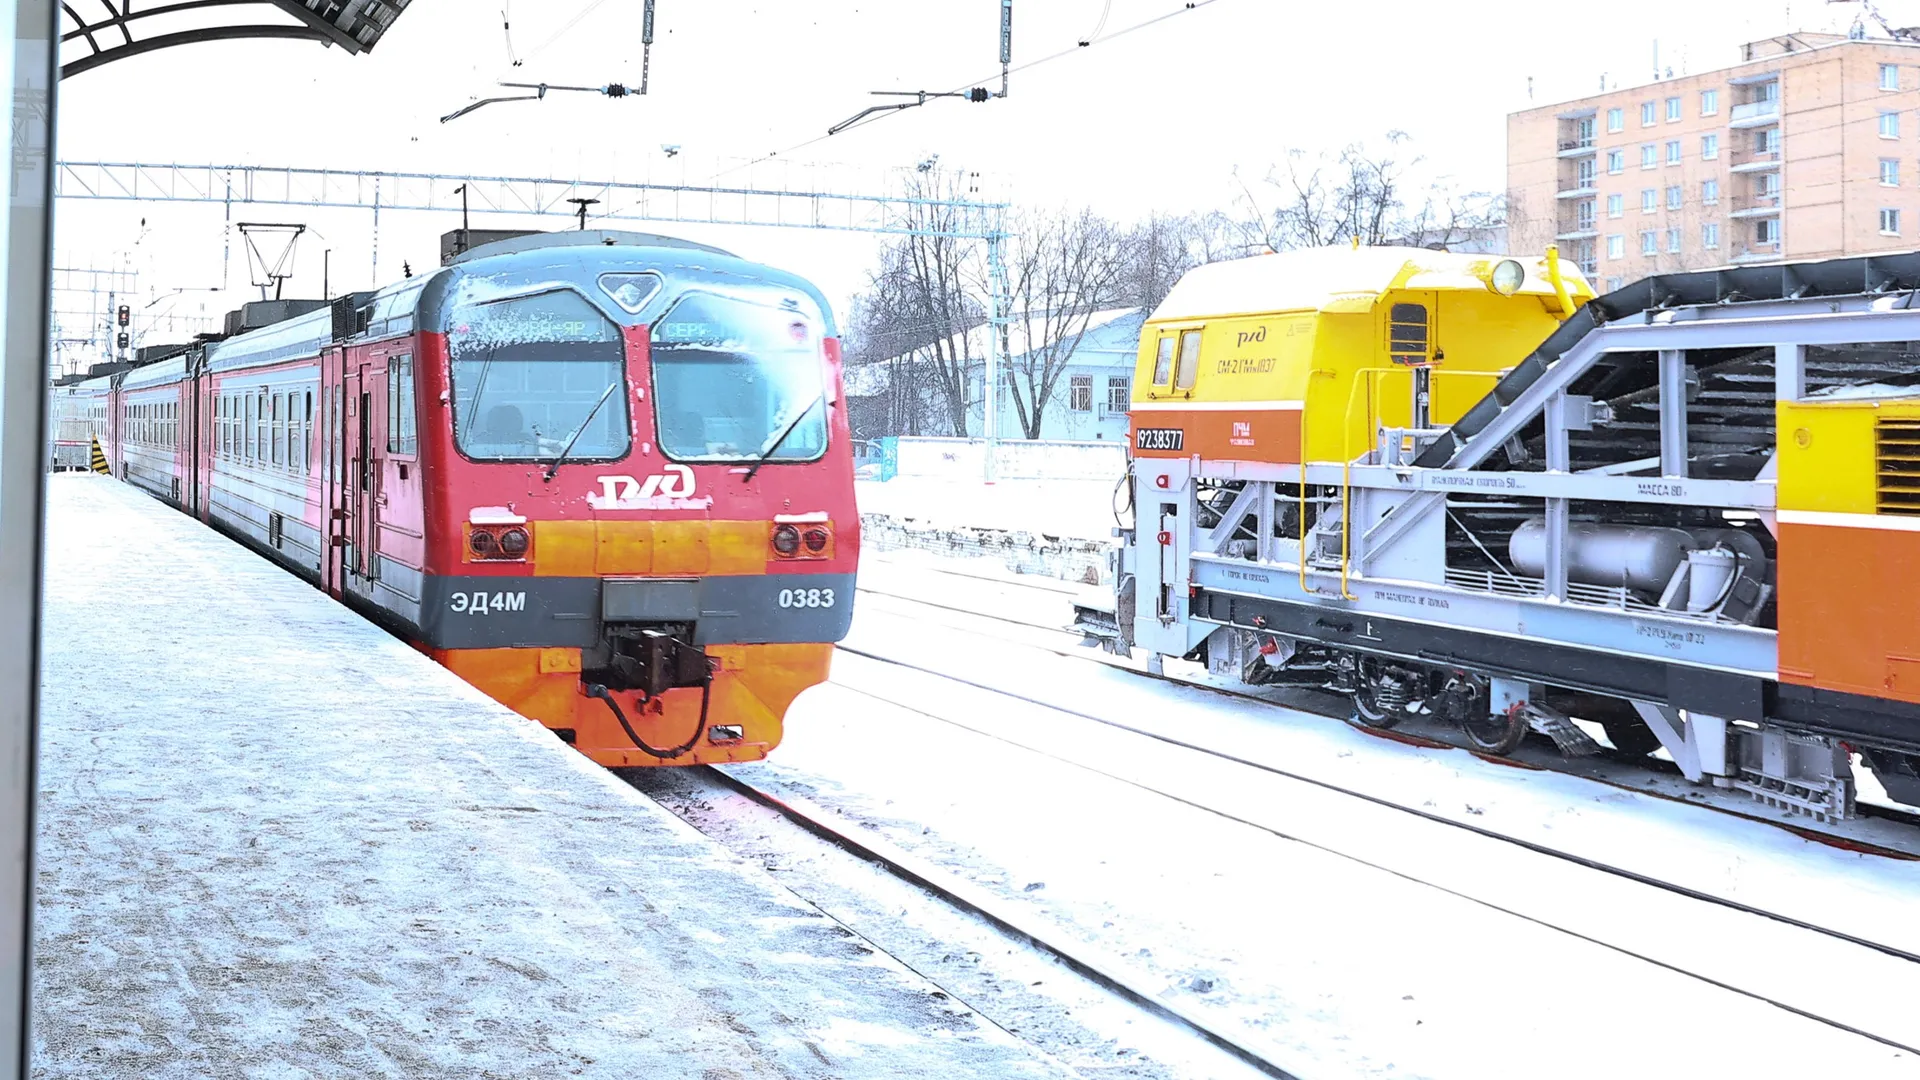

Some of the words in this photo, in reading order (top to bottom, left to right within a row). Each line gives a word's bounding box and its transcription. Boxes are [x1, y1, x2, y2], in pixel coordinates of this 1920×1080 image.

[1137, 429, 1183, 450] 19238377
[450, 592, 526, 615] ЭД4М
[779, 588, 835, 608] 0383
